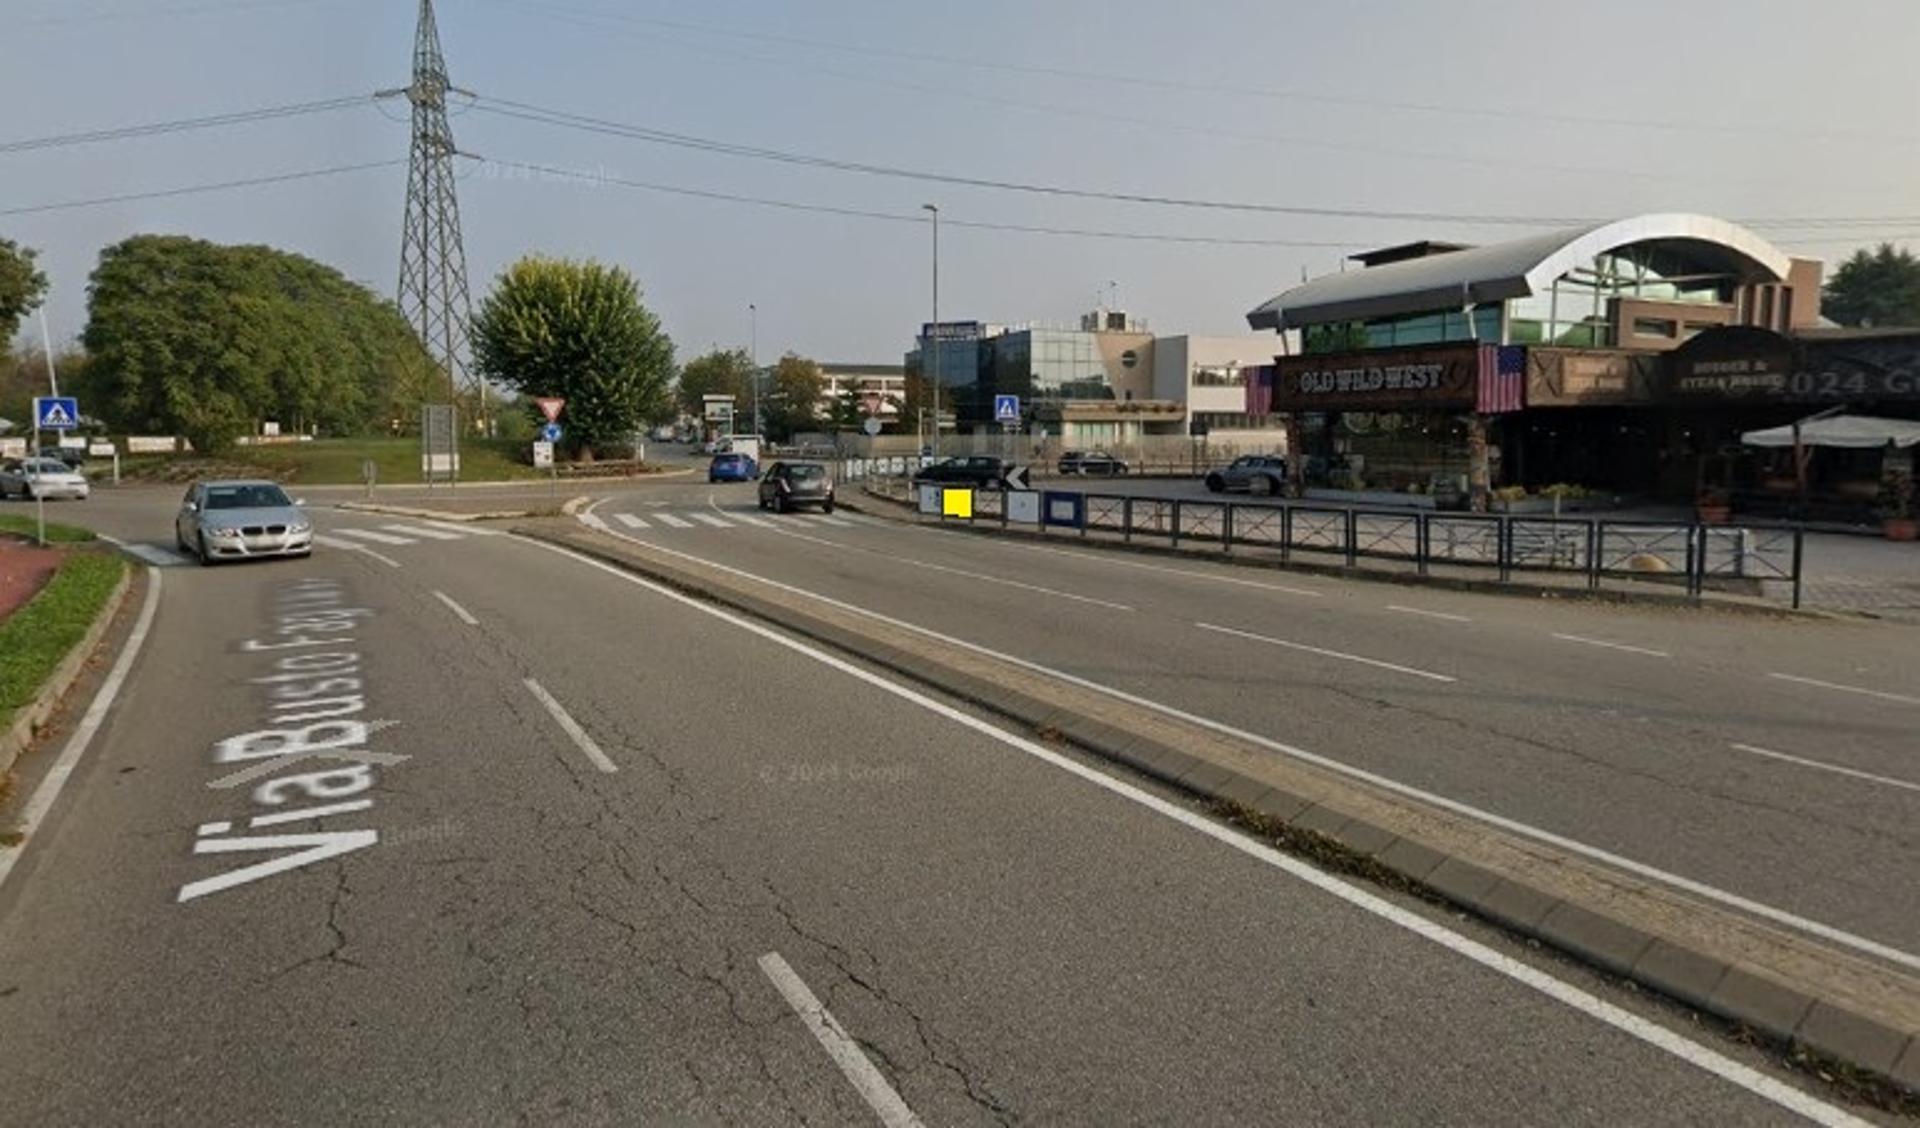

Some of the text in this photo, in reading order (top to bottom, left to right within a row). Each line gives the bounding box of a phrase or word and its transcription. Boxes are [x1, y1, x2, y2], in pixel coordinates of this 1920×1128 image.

[1300, 363, 1443, 393] OLD WILD WEST
[213, 650, 367, 763] Busto
[177, 762, 379, 902] Via
